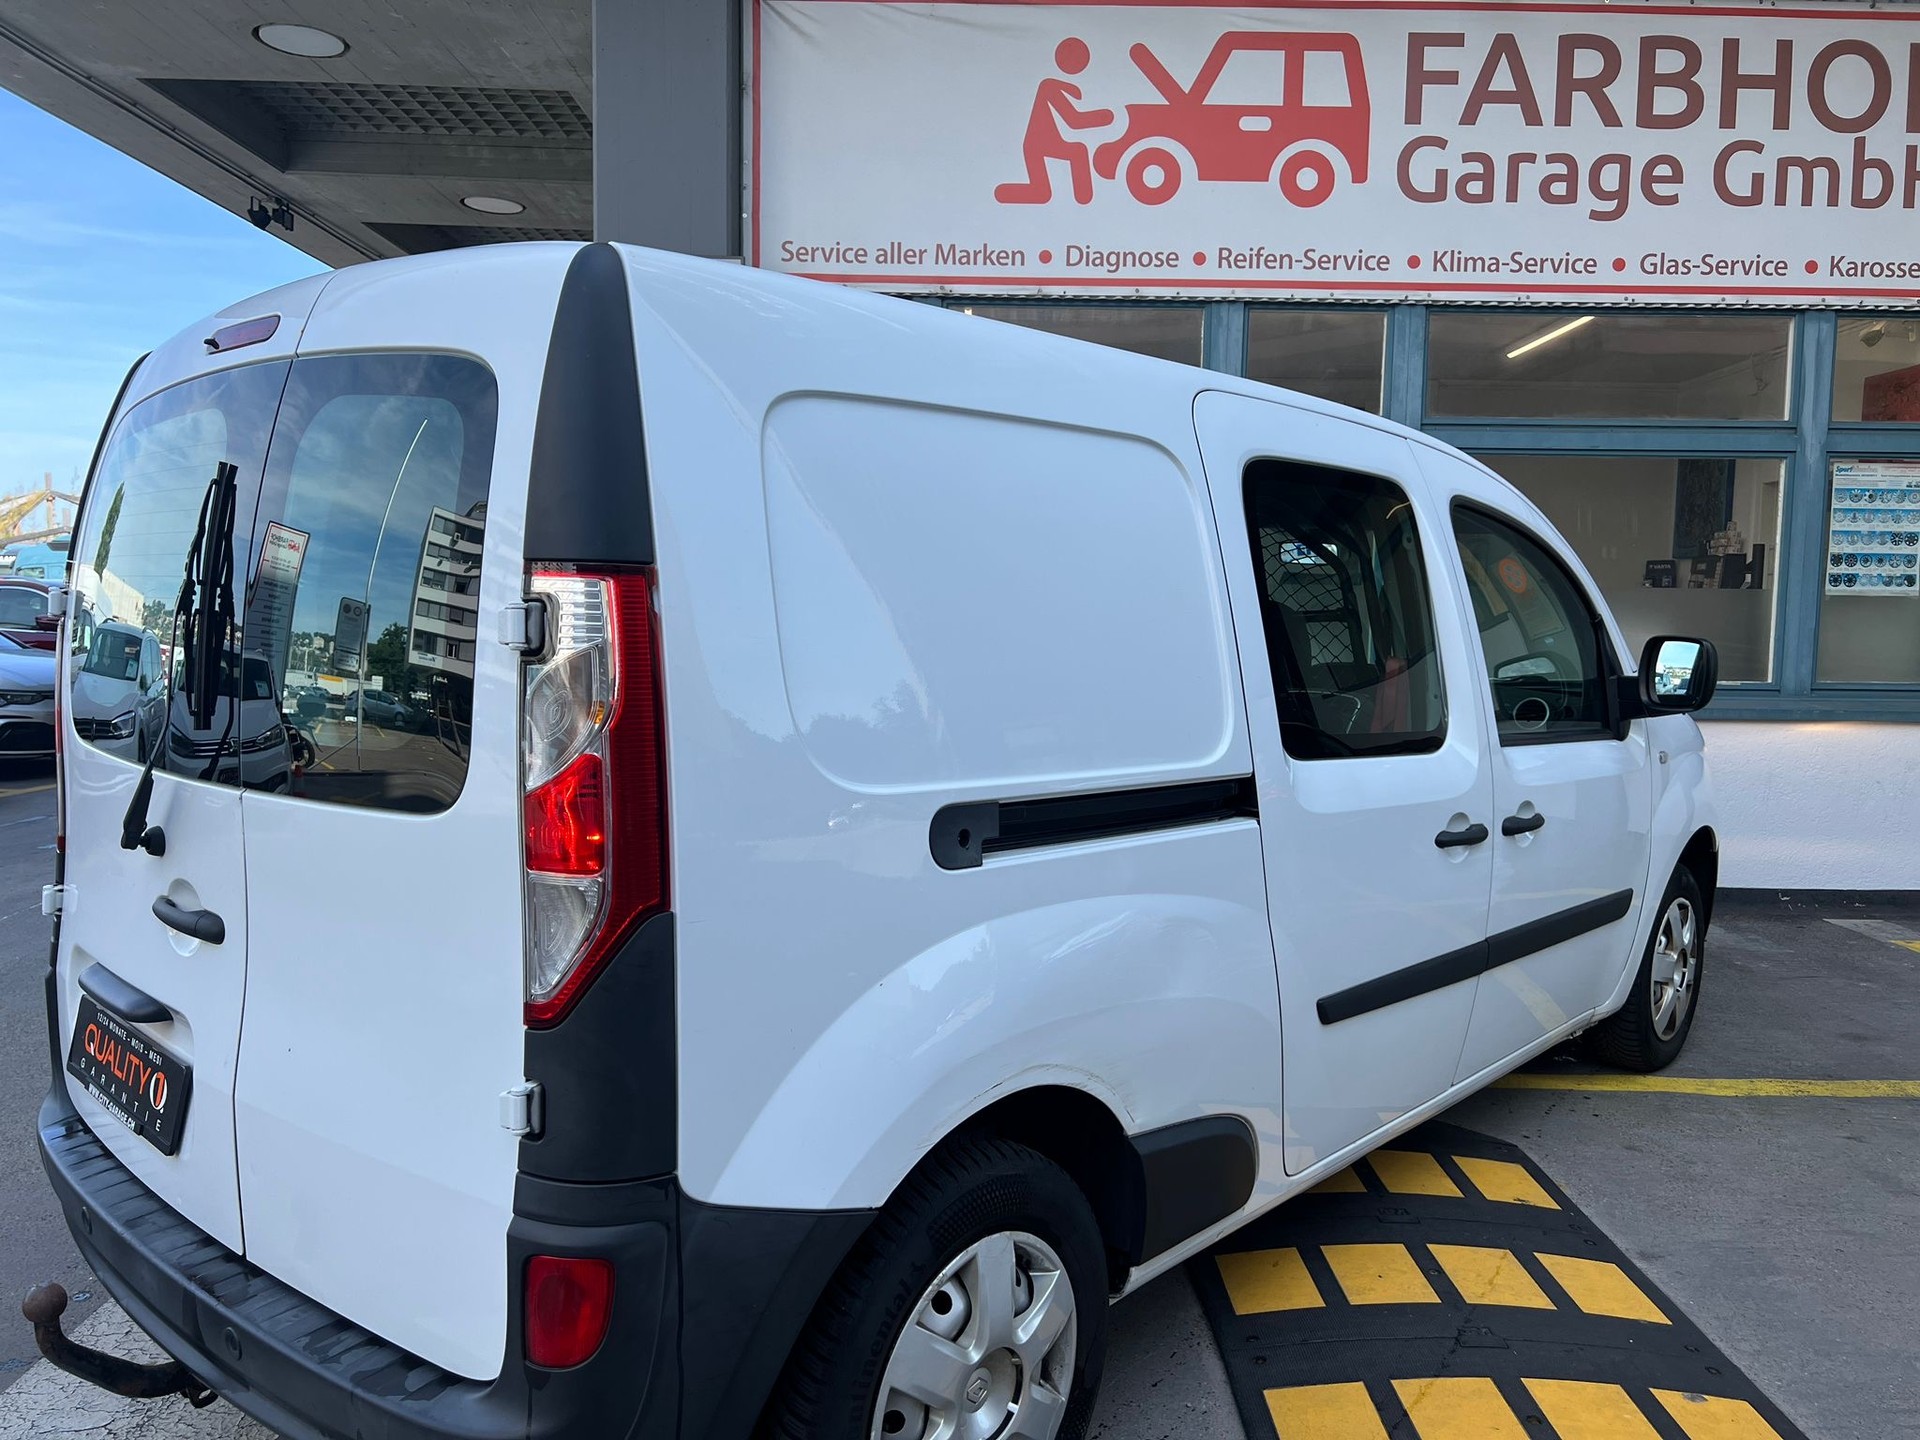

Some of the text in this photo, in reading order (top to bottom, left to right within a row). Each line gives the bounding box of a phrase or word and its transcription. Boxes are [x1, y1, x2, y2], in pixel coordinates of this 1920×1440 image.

[1397, 136, 1684, 221] Garage
[780, 241, 1920, 278] Service aller Marken Diagnose Reifen-Service Klima-Service Glas-Service Karosse
[84, 1023, 152, 1095] QUALITY
[109, 1020, 127, 1040] MONATE
[131, 1037, 144, 1053] MOIS
[80, 1057, 162, 1132] GARANTIE
